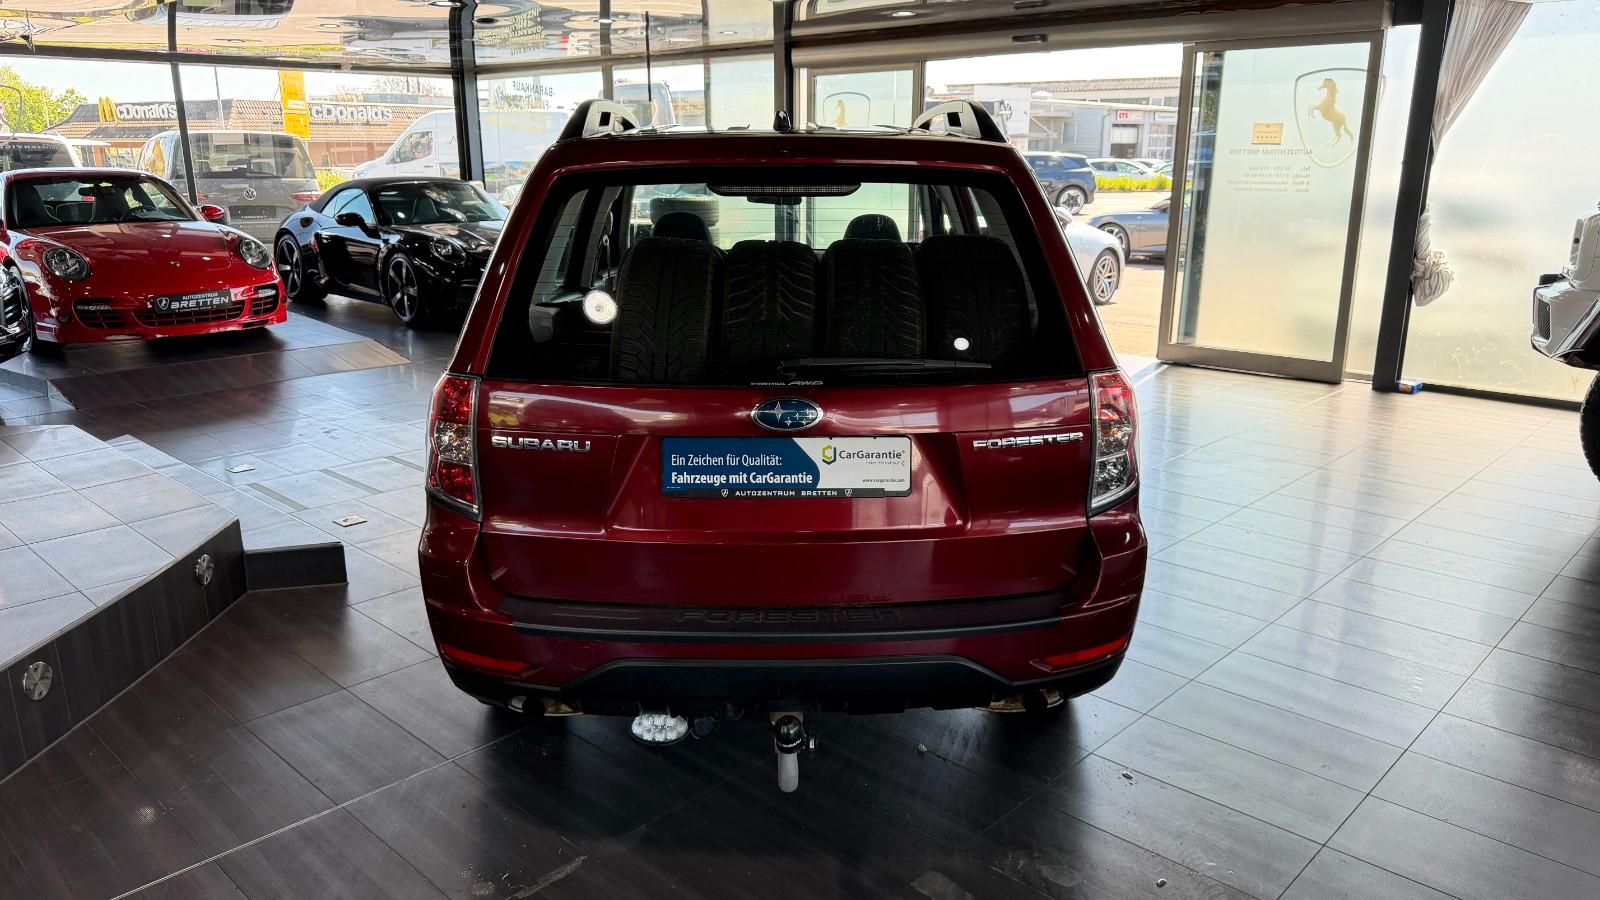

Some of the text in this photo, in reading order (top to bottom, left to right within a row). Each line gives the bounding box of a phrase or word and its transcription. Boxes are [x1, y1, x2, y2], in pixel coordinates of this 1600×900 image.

[310, 104, 392, 120] cDonald's
[170, 296, 230, 310] BRETTEN
[182, 292, 219, 301] AUTOZENTRUM
[491, 435, 591, 453] SUBARU
[972, 432, 1084, 451] FORESTER
[671, 453, 783, 467] Ein Zeichen für Qualität:
[671, 471, 813, 487] Fahrzeuge mit CarGarantie
[676, 606, 903, 624] FORESTER
